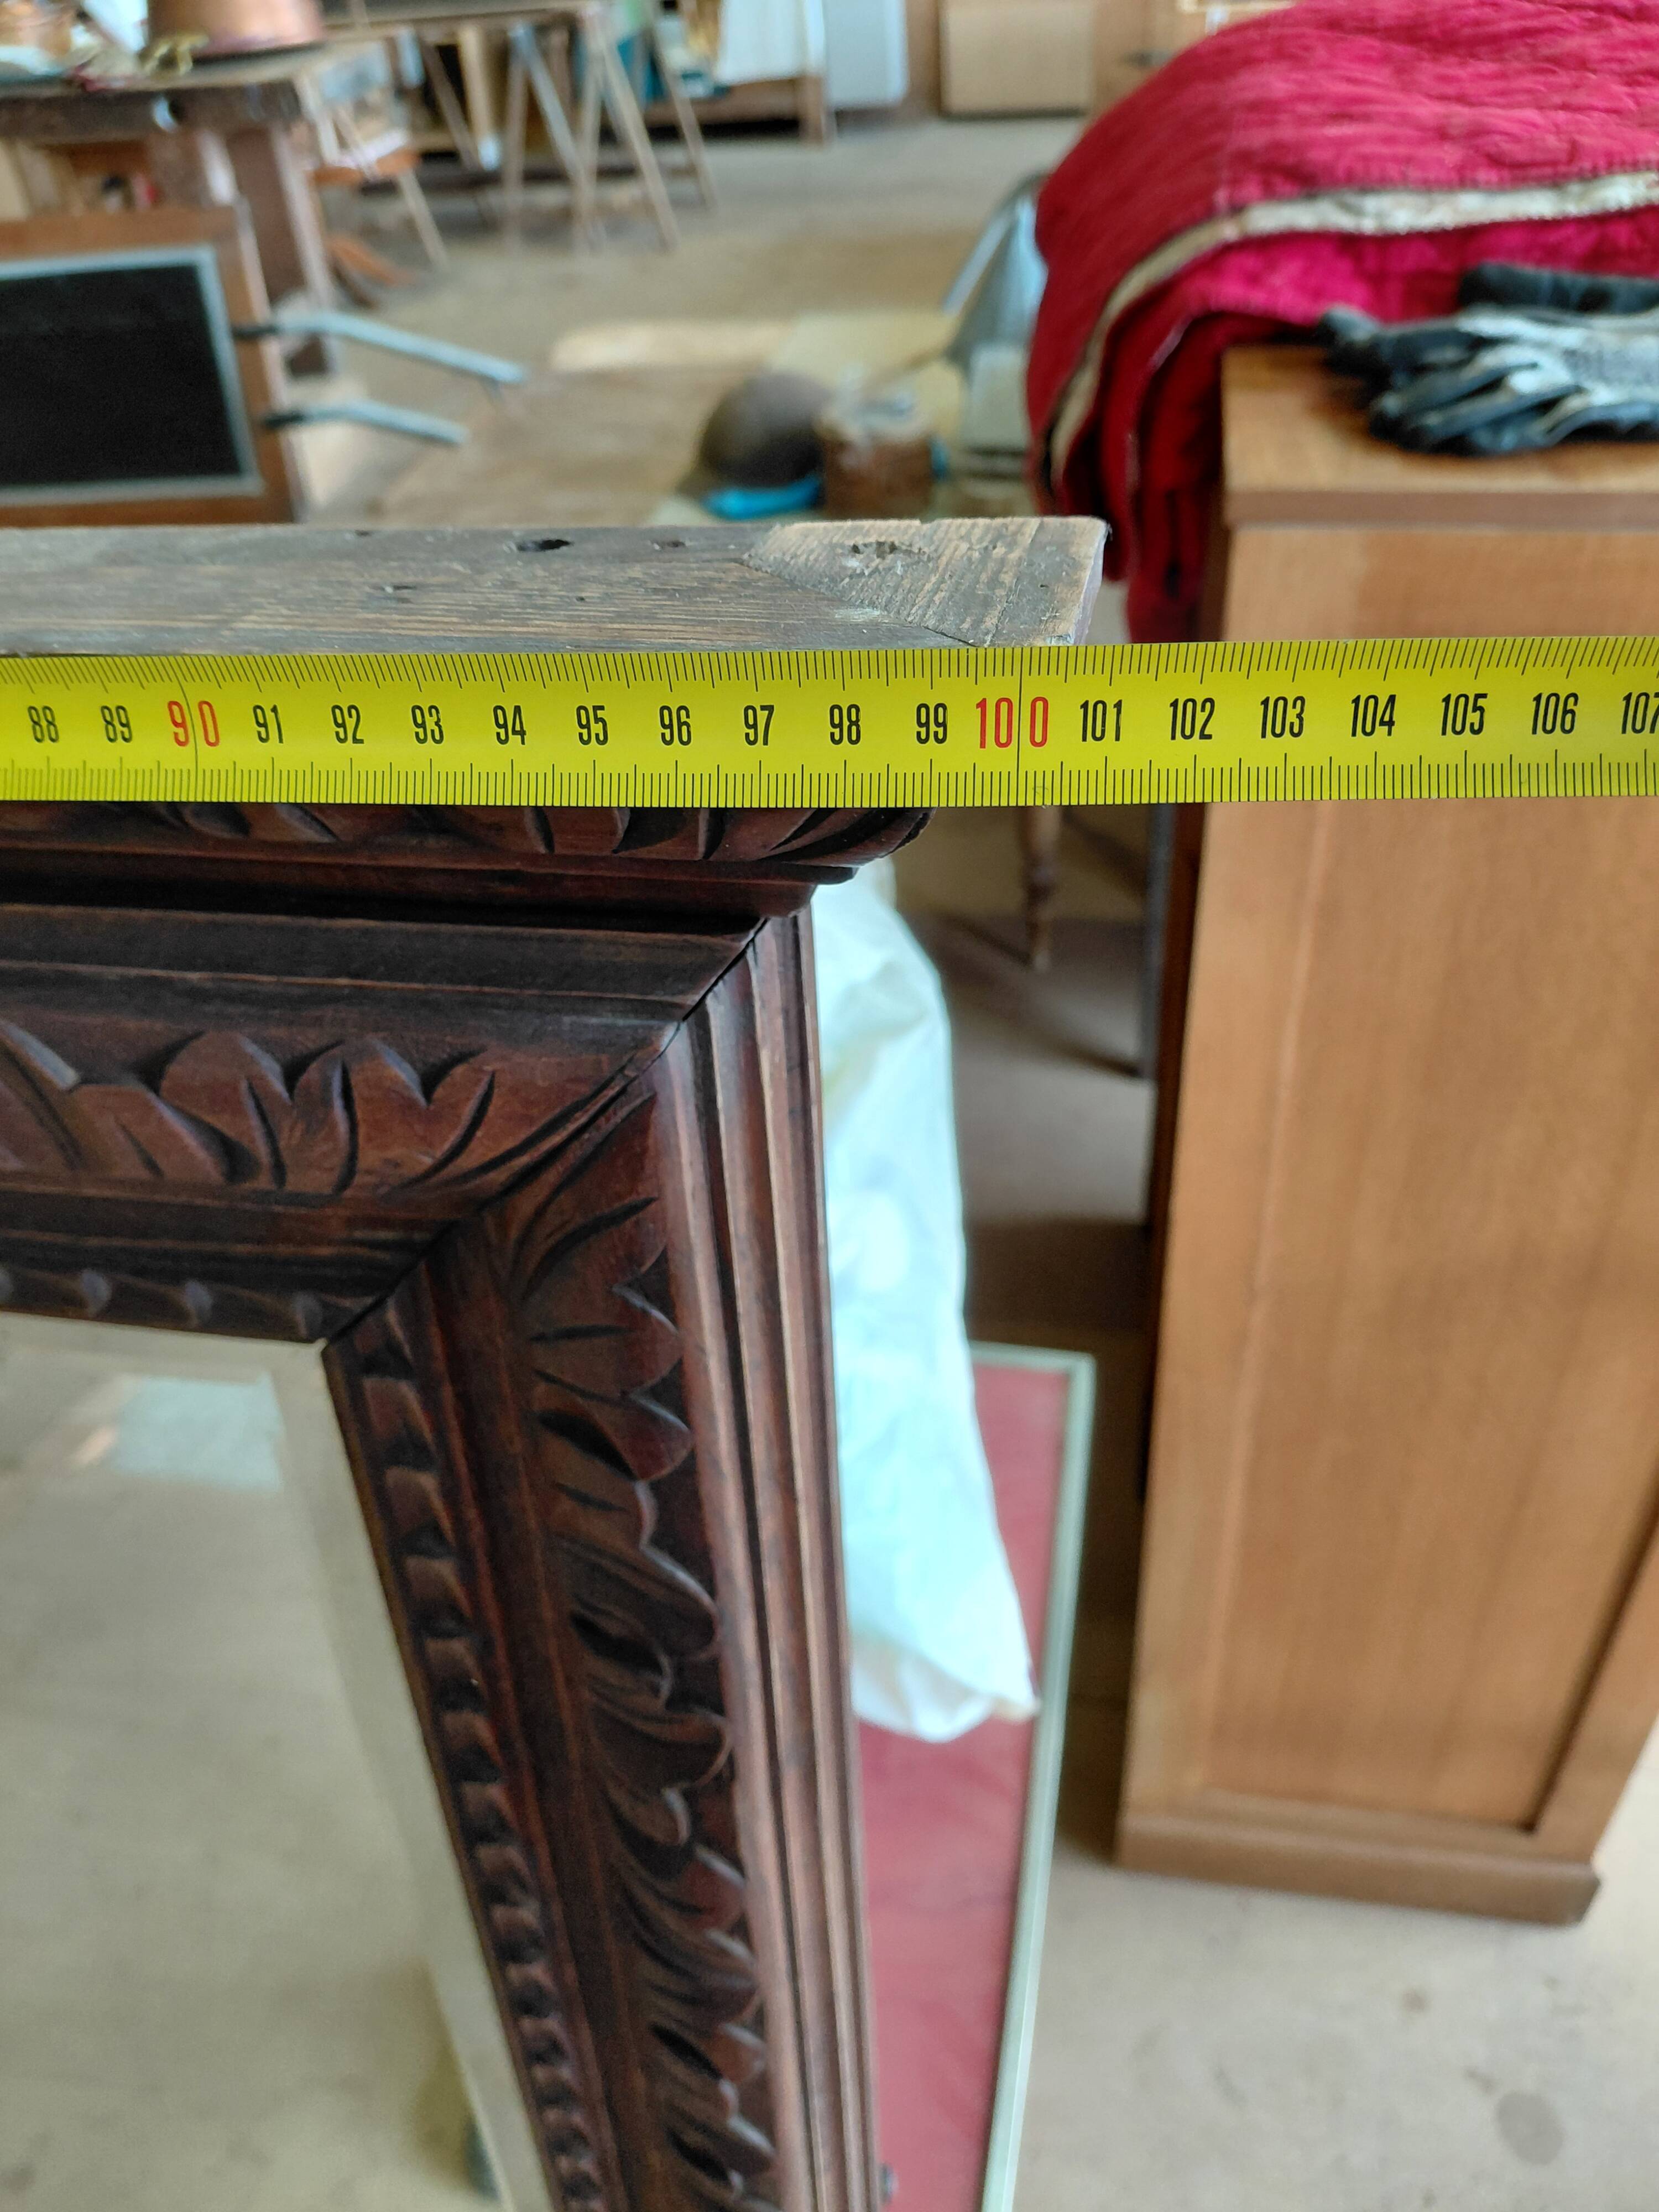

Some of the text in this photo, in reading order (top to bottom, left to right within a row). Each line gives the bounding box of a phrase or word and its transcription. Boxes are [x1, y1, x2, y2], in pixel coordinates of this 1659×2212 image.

[27, 706, 59, 743] 88
[100, 705, 132, 743] 89
[167, 700, 220, 747] 90
[253, 704, 284, 744] 91
[331, 705, 364, 744] 92
[411, 705, 444, 744] 93
[493, 705, 527, 745] 94
[576, 705, 608, 746] 95
[659, 705, 692, 746] 96
[743, 705, 775, 746] 97
[829, 703, 861, 745] 98
[916, 702, 948, 745] 99
[975, 696, 1049, 749] 100
[1079, 699, 1123, 742] 101
[1169, 697, 1215, 741] 102
[1260, 696, 1306, 739] 103
[1351, 694, 1397, 738] 104
[1441, 693, 1489, 736] 105
[1531, 692, 1579, 735] 106
